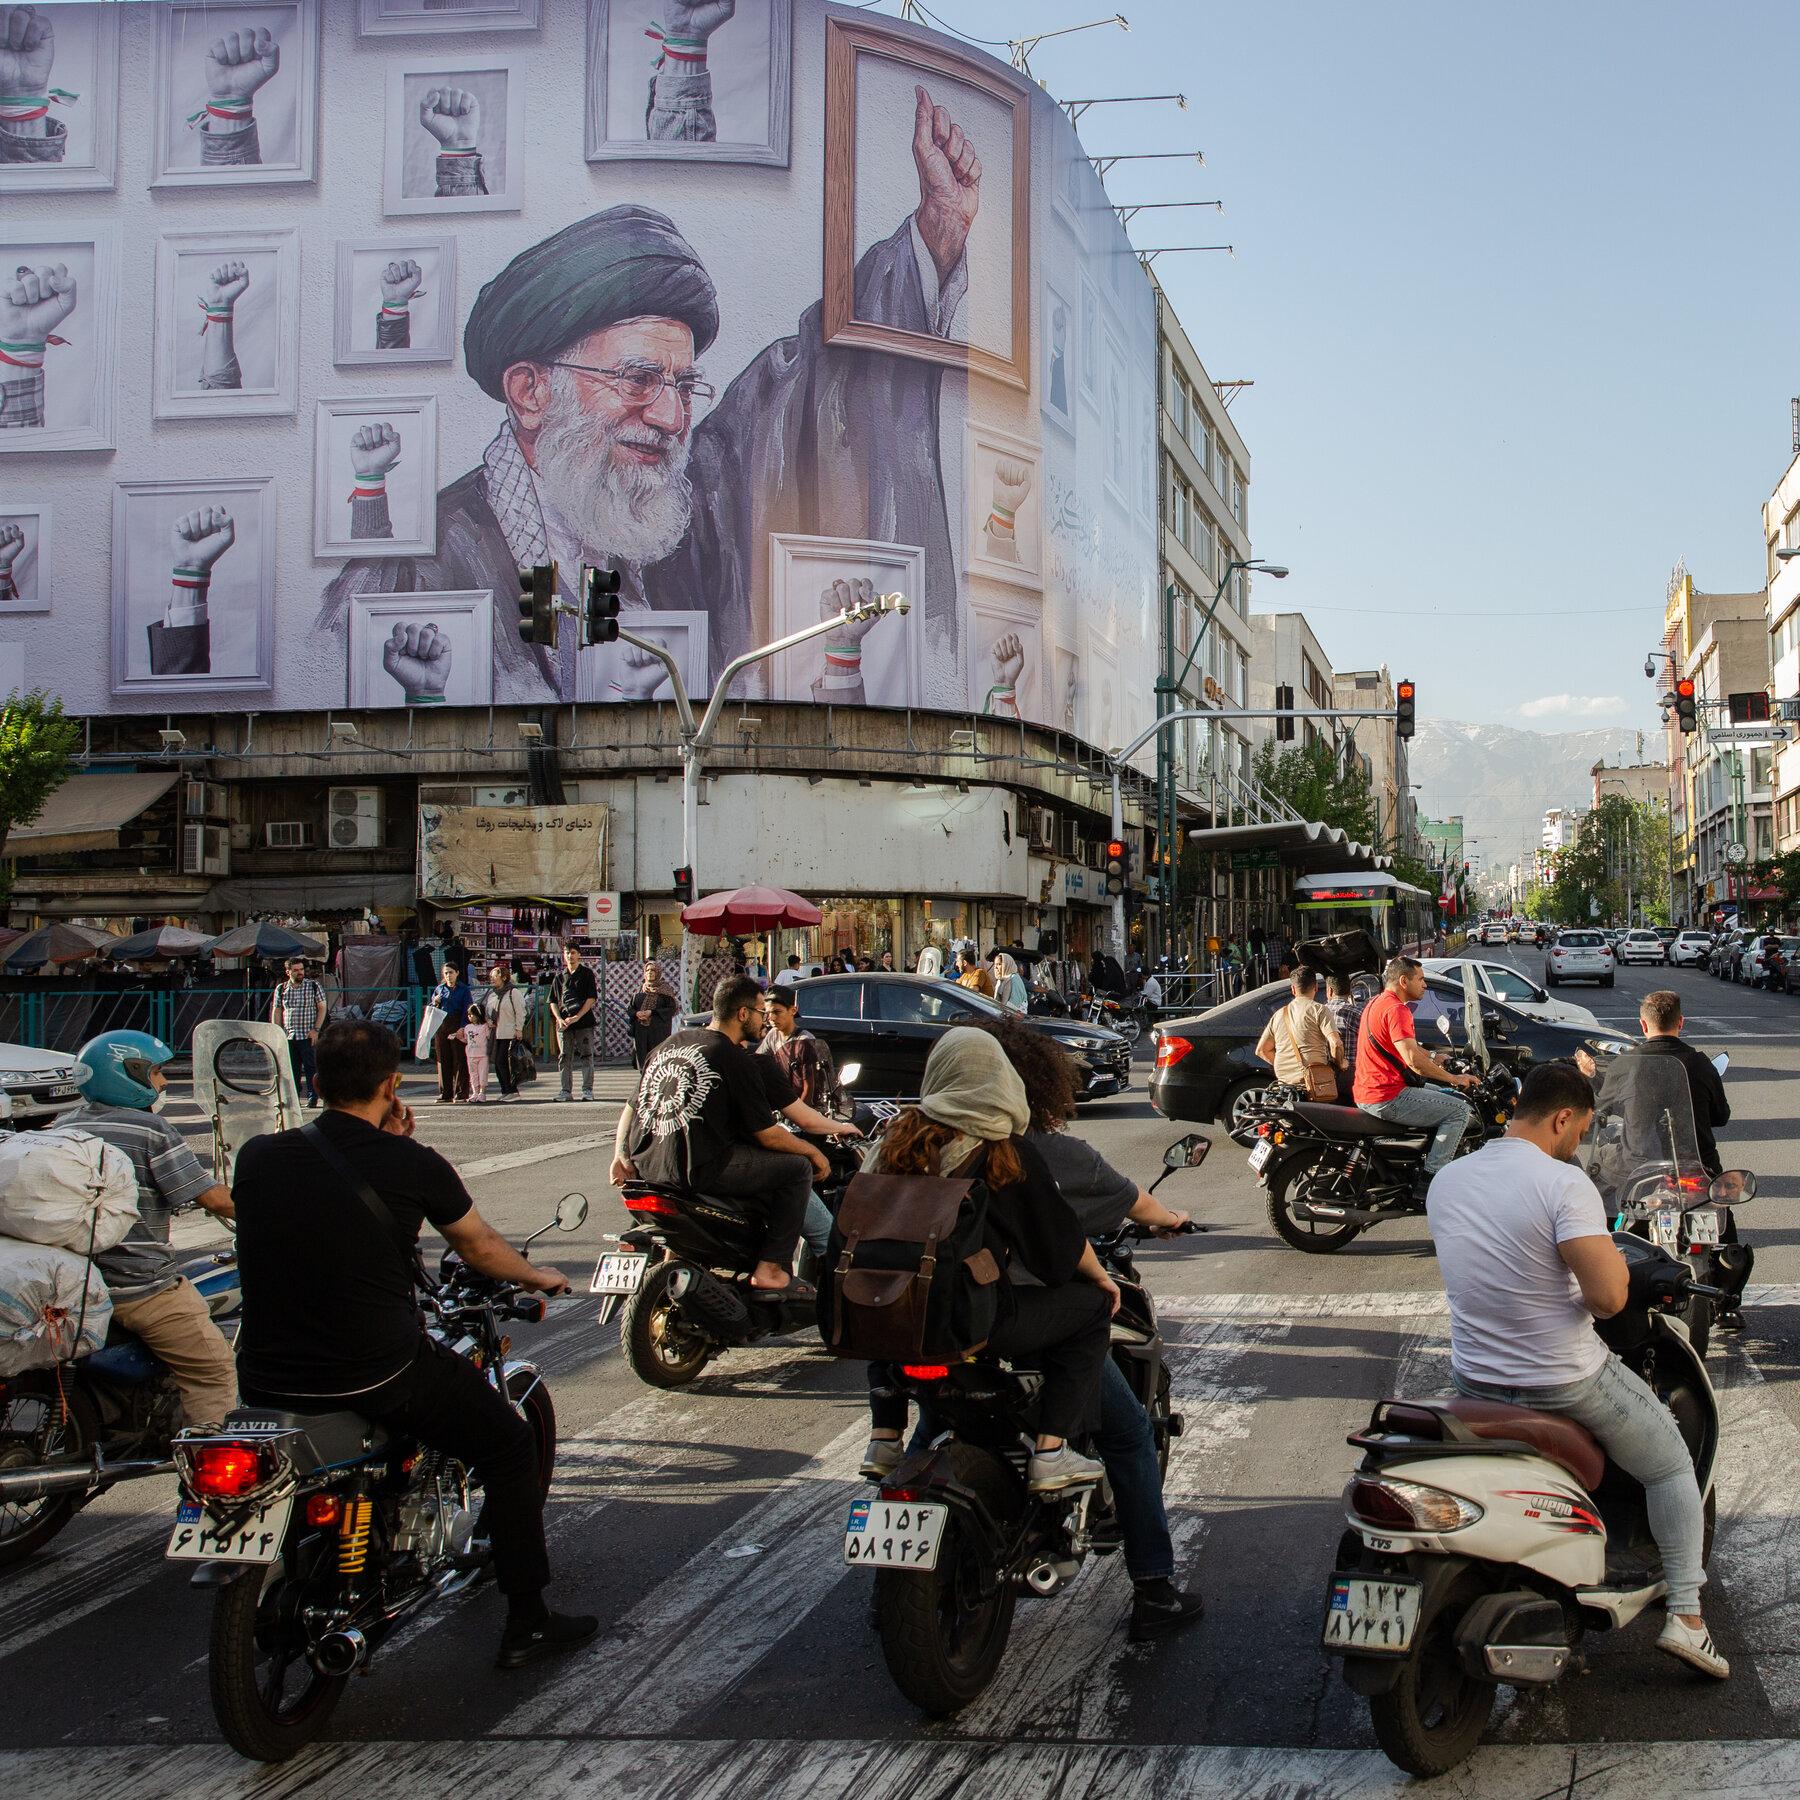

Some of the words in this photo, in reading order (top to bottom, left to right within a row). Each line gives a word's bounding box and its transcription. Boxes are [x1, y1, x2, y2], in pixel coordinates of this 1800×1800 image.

[1711, 731, 1735, 741] اسلامی
[1736, 731, 1763, 740] جمهوری
[476, 816, 495, 833] روشا
[497, 817, 536, 832] بدلیجات
[538, 821, 543, 833] و
[546, 816, 564, 830] لاک
[565, 817, 593, 832] دنیای
[617, 1259, 640, 1271] ۱۵۷
[226, 1421, 279, 1431] KAVIR
[180, 1516, 199, 1524] IRAN
[885, 1507, 930, 1532] ۱۵۴
[848, 1536, 931, 1563] ۵۸۹۴۶
[1370, 1536, 1393, 1550] TVS
